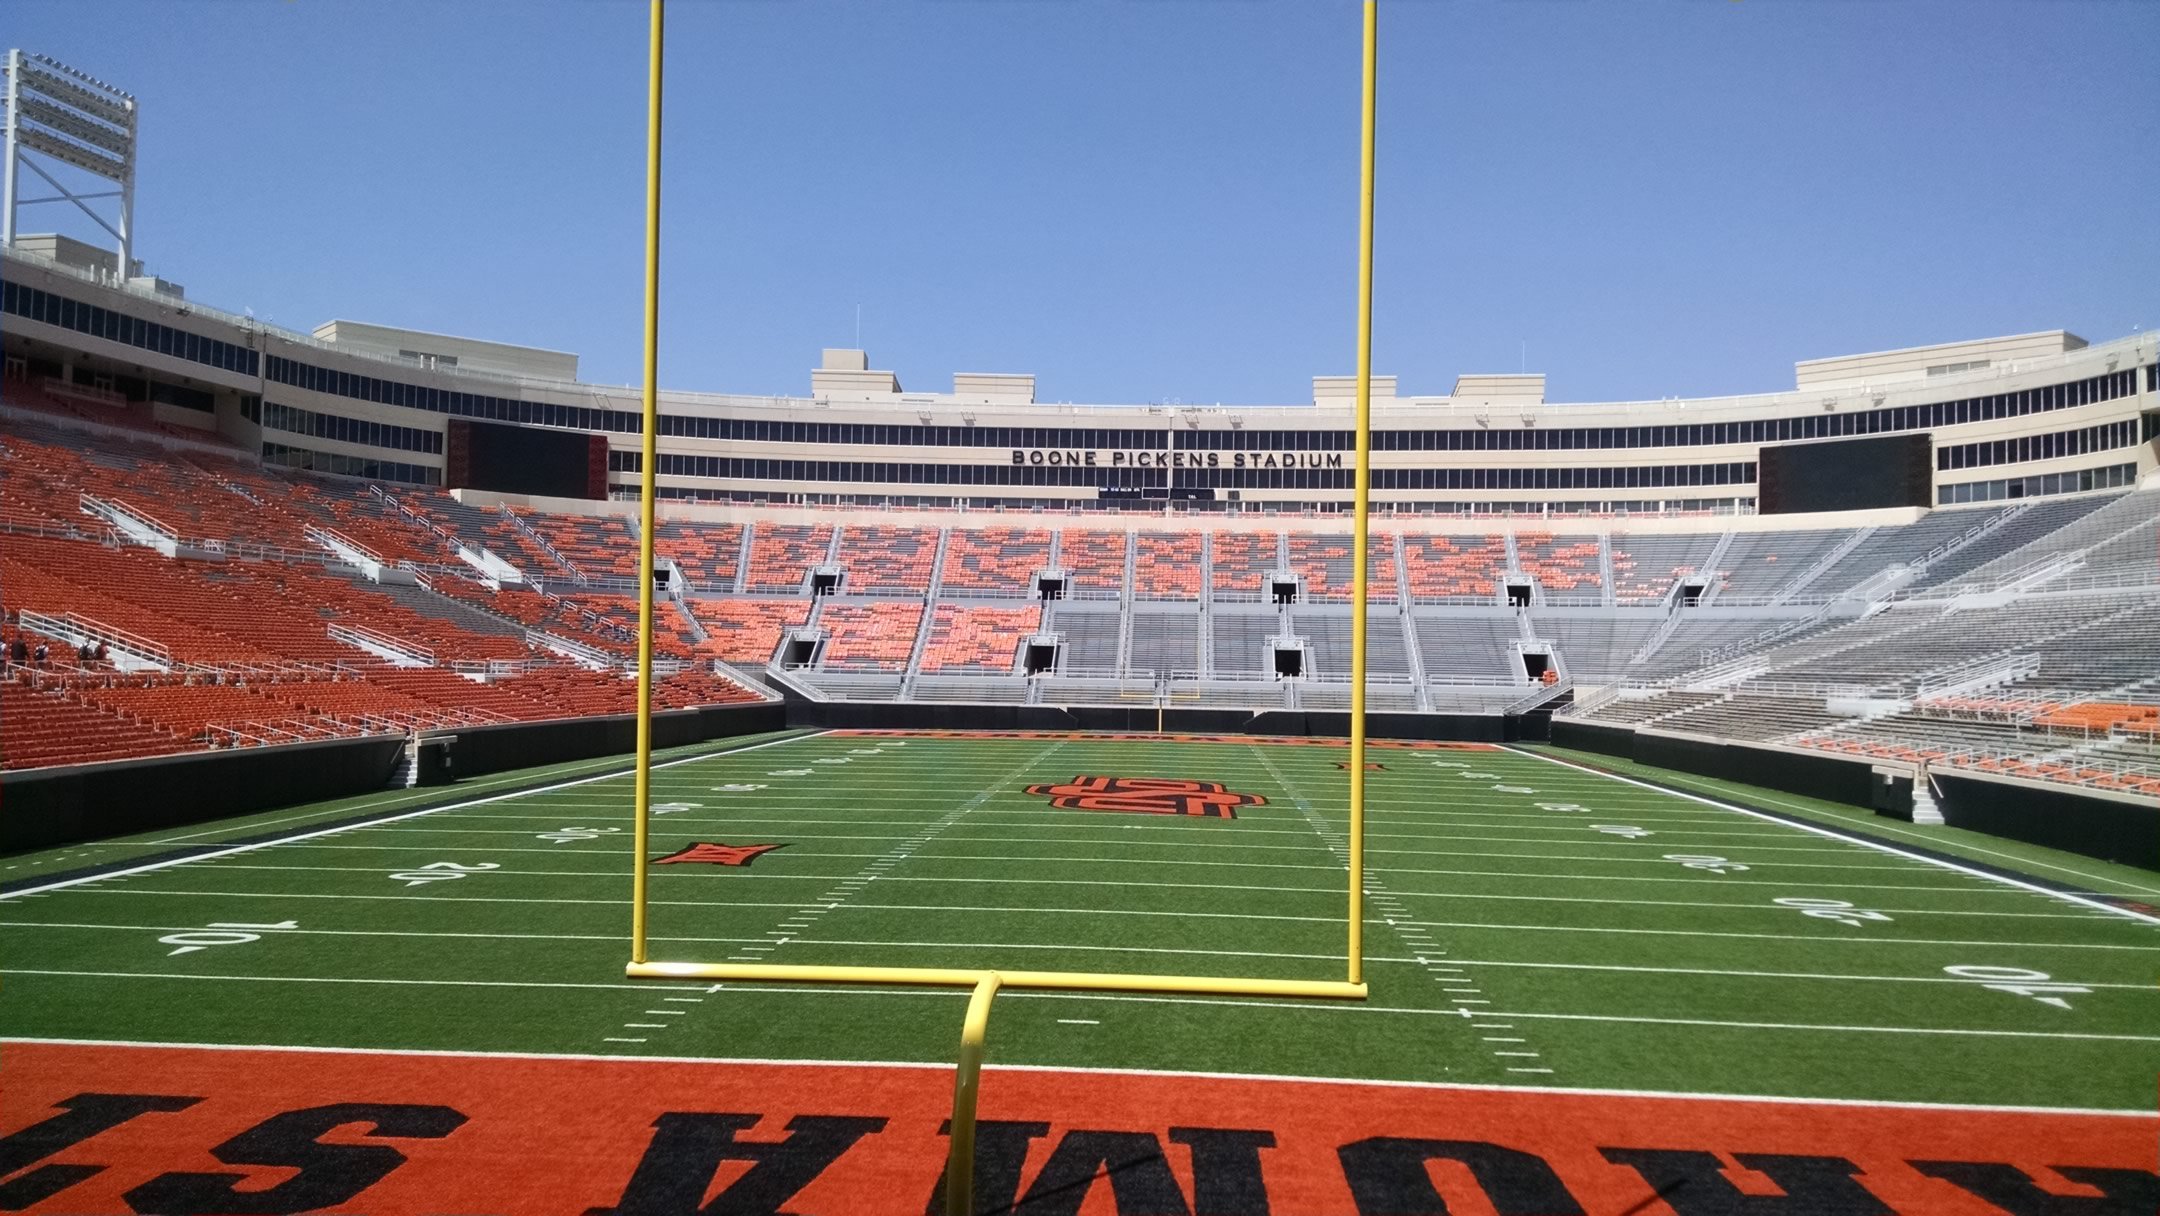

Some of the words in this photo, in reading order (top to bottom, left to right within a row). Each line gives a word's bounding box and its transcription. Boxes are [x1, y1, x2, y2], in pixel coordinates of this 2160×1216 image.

[1012, 449, 1097, 466] BOONE
[1113, 451, 1220, 468] PICKENS
[1233, 452, 1343, 469] STADIUM
[388, 861, 501, 881] 20
[1772, 897, 1895, 921] 20
[158, 920, 299, 946] 10
[1943, 965, 2094, 996] 10
